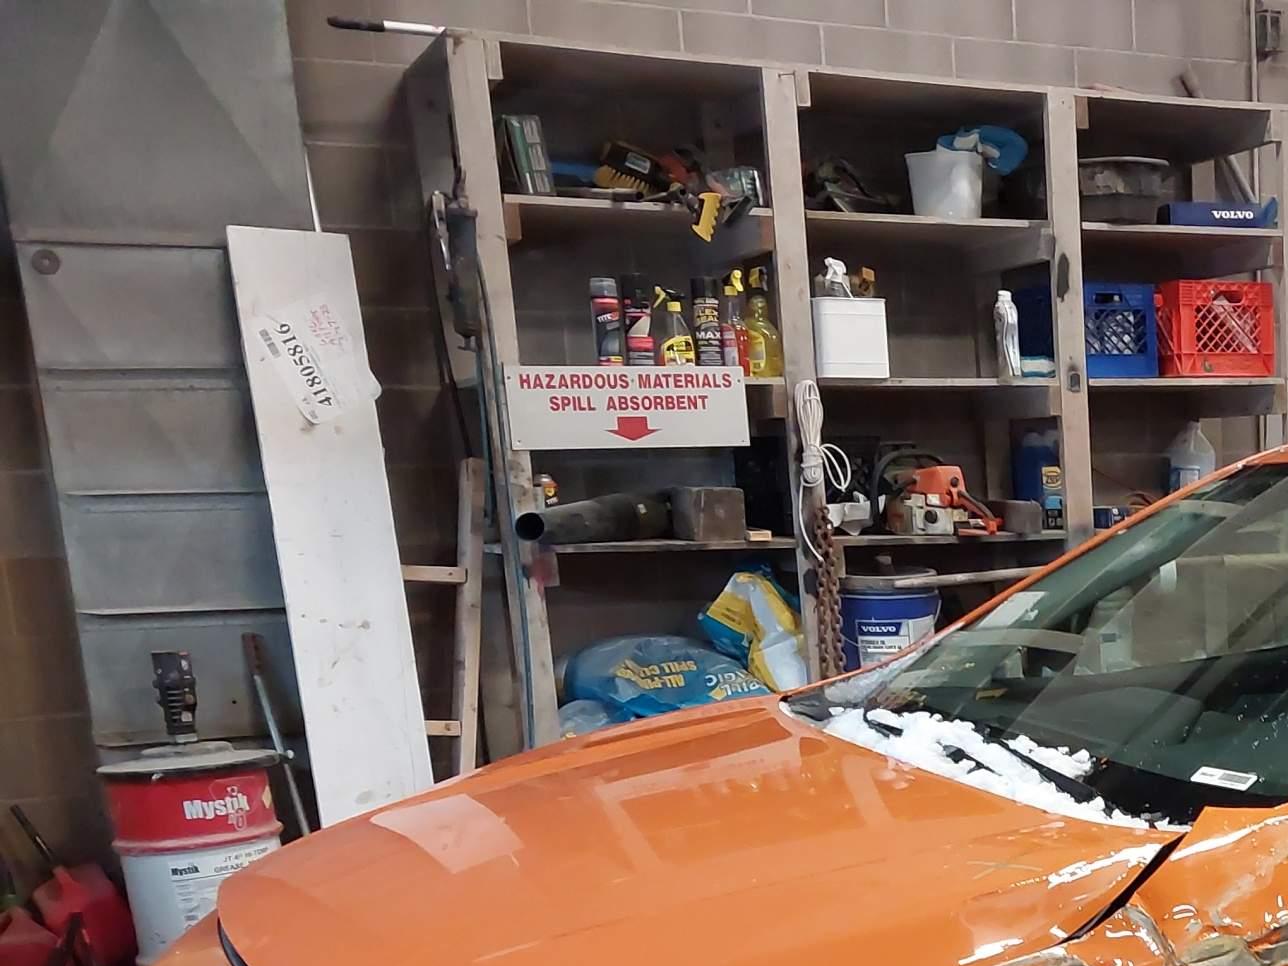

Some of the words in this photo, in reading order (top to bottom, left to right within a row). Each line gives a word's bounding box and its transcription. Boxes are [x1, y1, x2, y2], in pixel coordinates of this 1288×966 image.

[1211, 210, 1254, 219] VOLVO
[696, 330, 721, 340] MAX
[273, 323, 333, 407] 41805816
[519, 373, 630, 390] HAZARDOUS
[638, 372, 732, 389] MATERIALS
[549, 395, 597, 411] SPILL
[606, 395, 709, 411] ABSORBENT
[860, 625, 897, 633] VOLVO
[662, 660, 697, 674] SPILL
[182, 786, 250, 821] Mystik
[171, 864, 200, 876] Mystik
